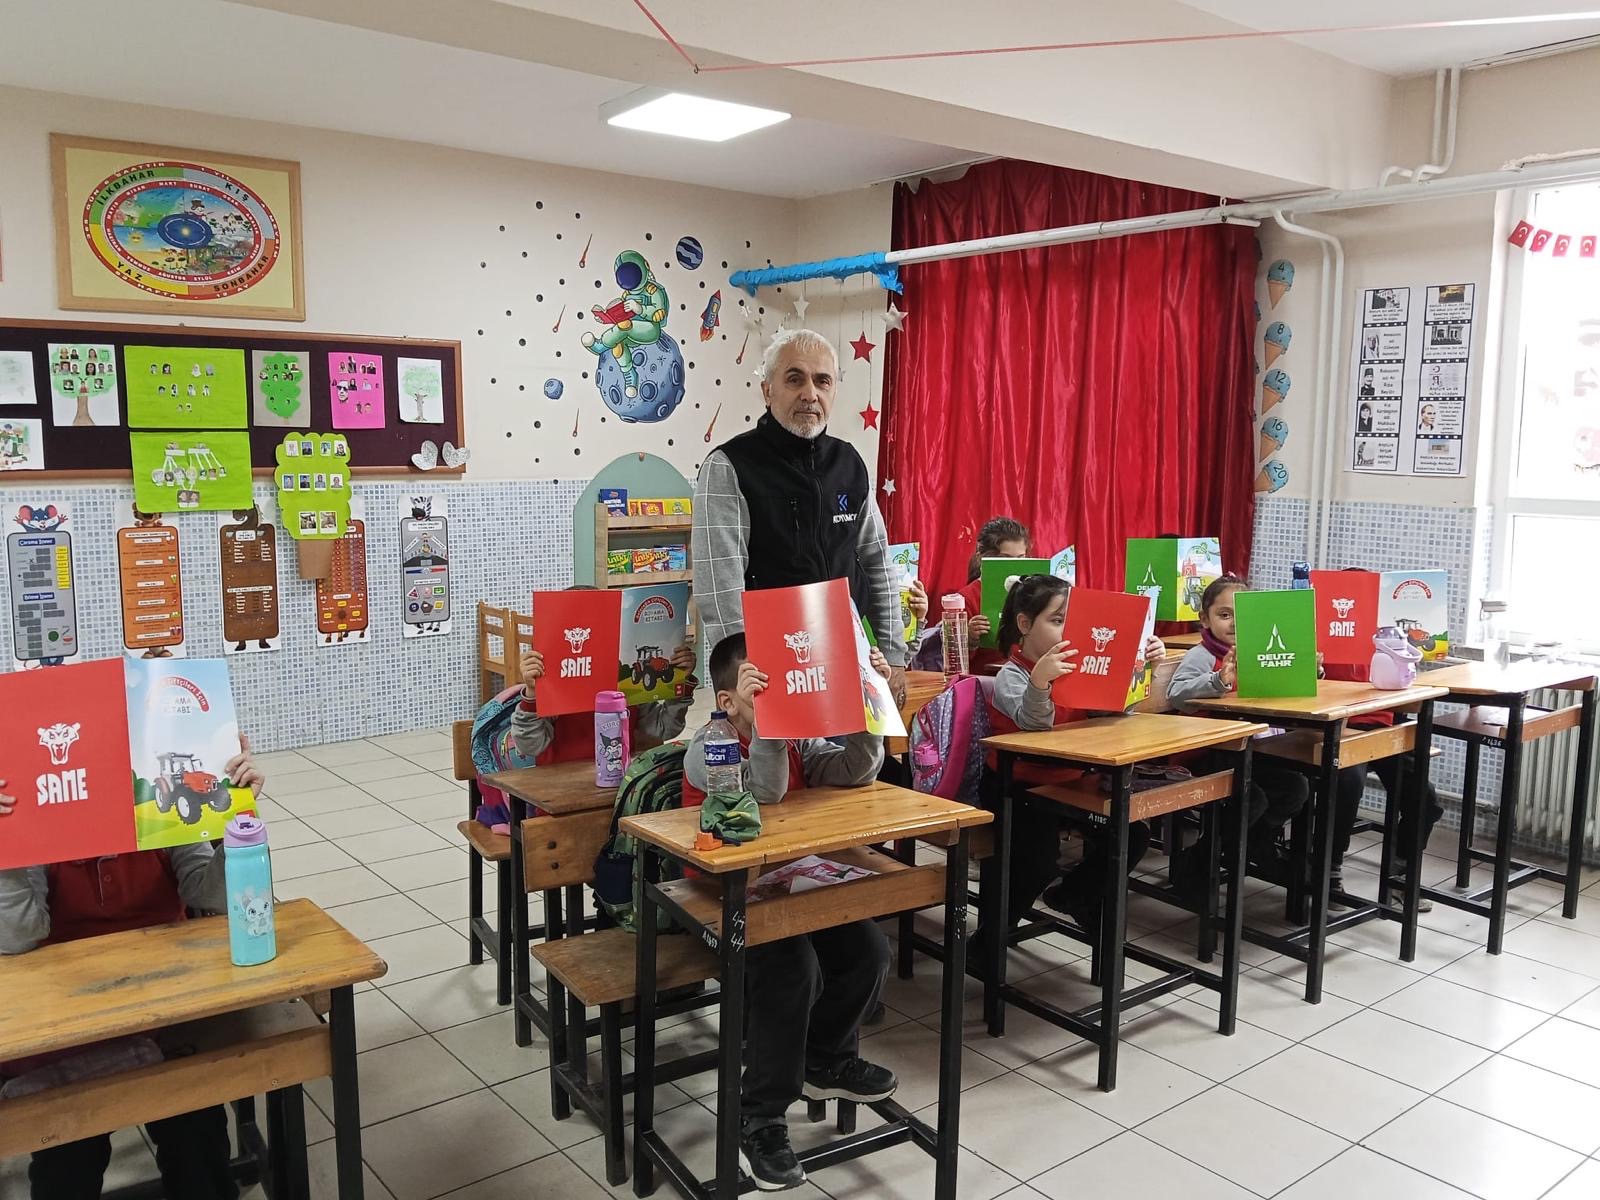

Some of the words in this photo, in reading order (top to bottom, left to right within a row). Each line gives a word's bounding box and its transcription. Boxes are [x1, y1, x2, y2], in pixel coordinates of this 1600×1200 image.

[96, 170, 155, 206] İLKBAHAR
[225, 182, 249, 202] KIŞ
[117, 261, 142, 281] YAZ
[213, 255, 269, 292] SONBAHAR
[1278, 262, 1285, 273] 4
[1277, 323, 1285, 334] 8
[1275, 371, 1287, 383] 12
[1272, 418, 1283, 431] 16
[1273, 463, 1287, 479] 20
[1329, 621, 1356, 638] SAME
[1080, 655, 1111, 676] SAME
[1257, 652, 1296, 661] DEUTZ
[1260, 659, 1292, 668] FAHR
[560, 656, 592, 679] SAME
[785, 665, 828, 695] SAME
[35, 767, 89, 806] SAME
